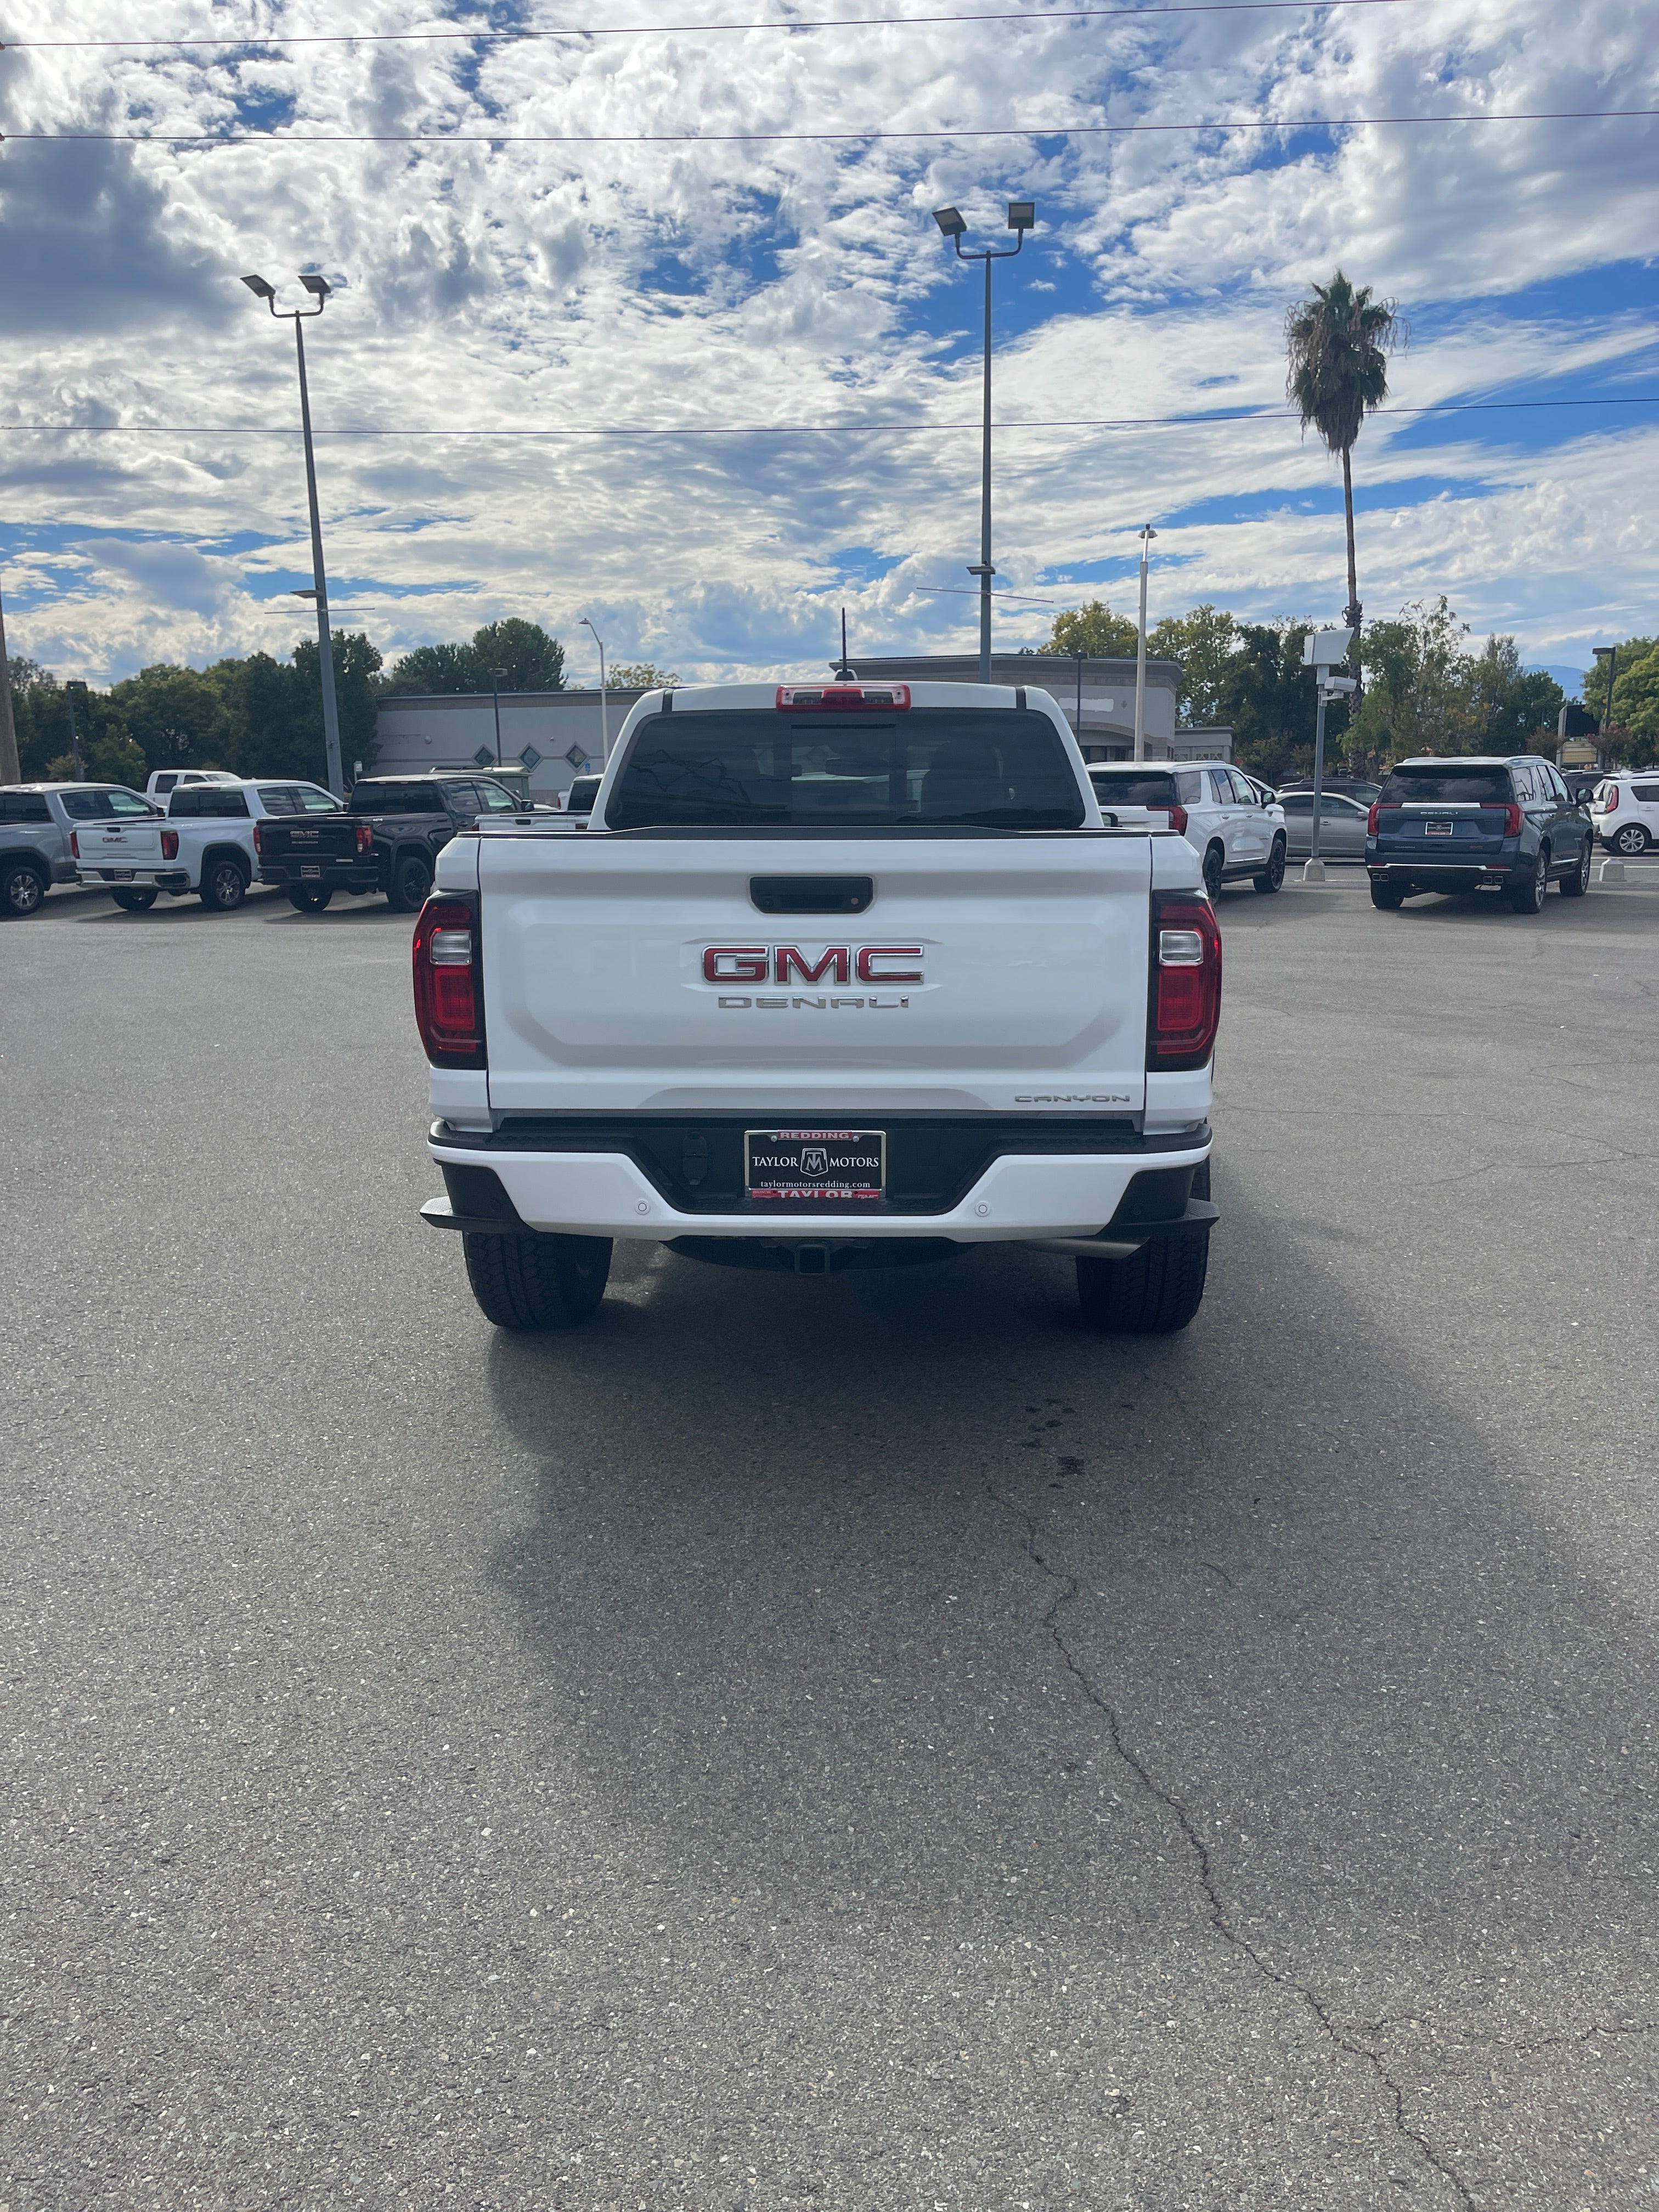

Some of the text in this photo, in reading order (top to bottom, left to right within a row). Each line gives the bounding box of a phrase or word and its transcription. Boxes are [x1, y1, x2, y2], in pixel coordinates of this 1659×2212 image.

[290, 830, 319, 838] GMC
[702, 945, 924, 986] GMC
[718, 996, 910, 1009] DENALI
[752, 1156, 799, 1167] TAYLOR
[829, 1157, 879, 1168] MOTORS
[760, 1180, 871, 1189] taylormotorsredding.com
